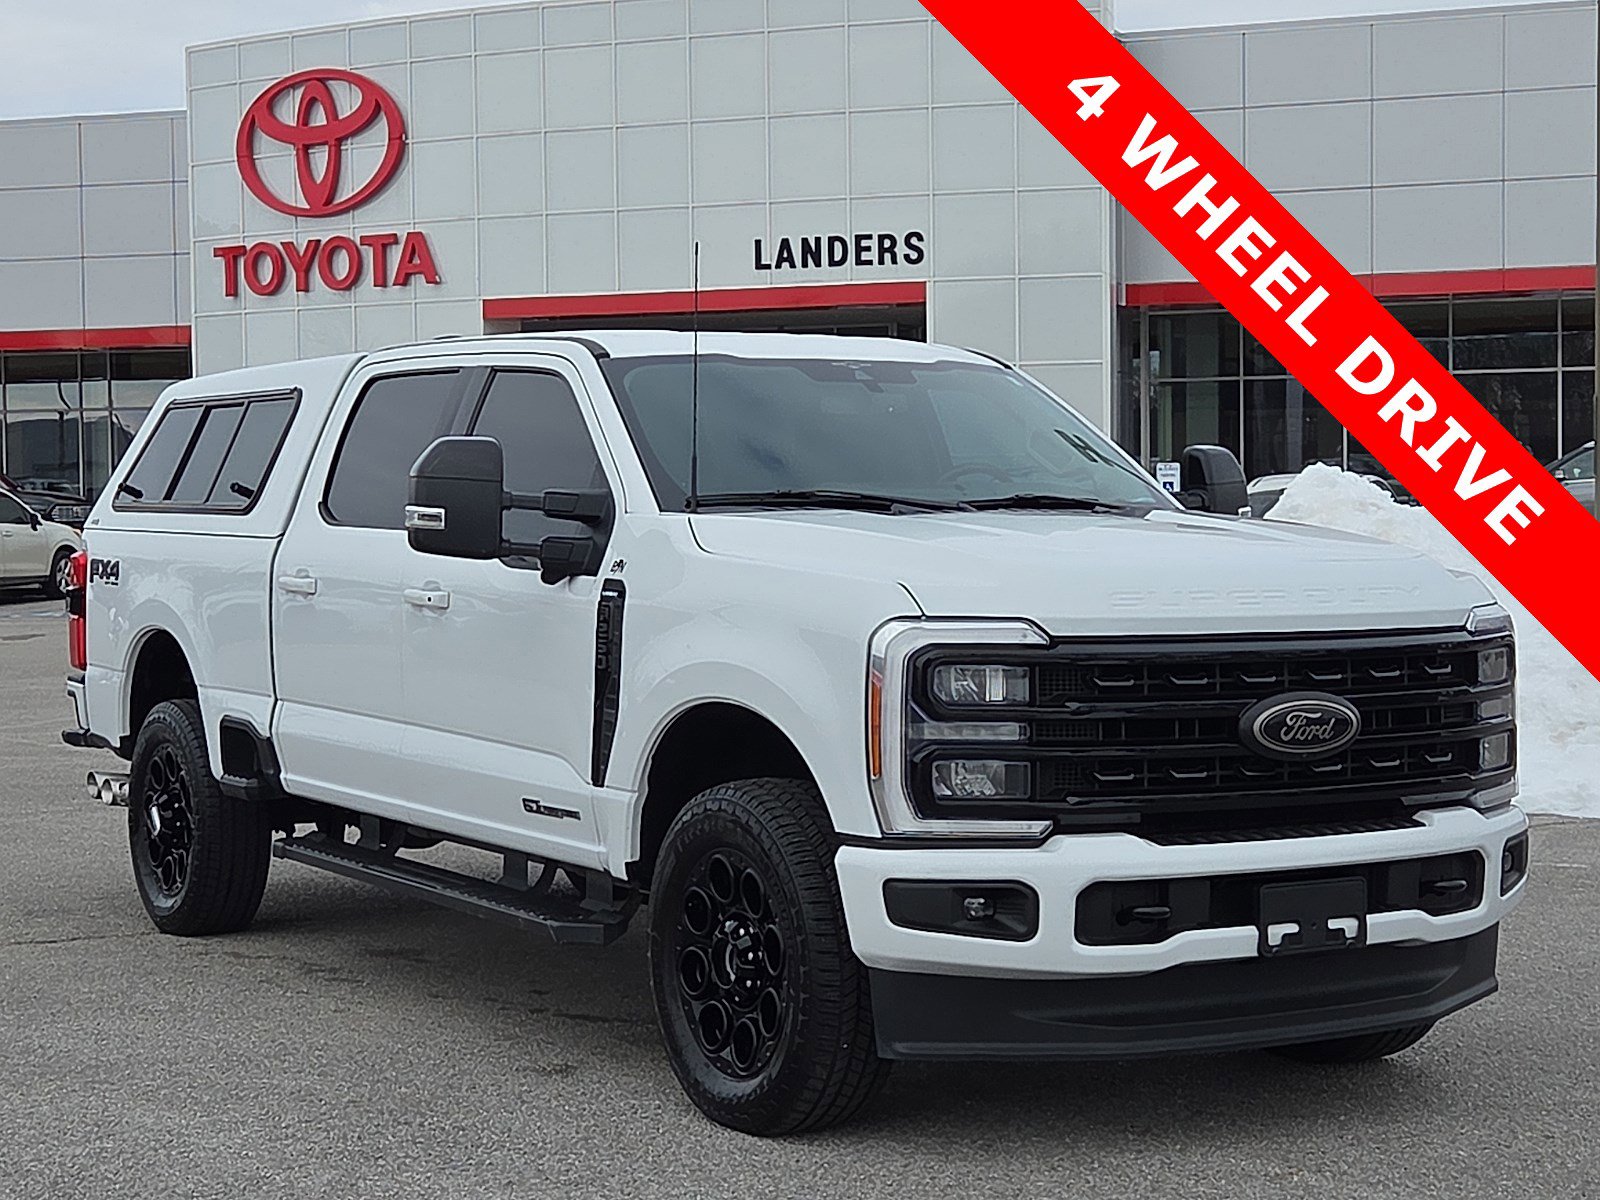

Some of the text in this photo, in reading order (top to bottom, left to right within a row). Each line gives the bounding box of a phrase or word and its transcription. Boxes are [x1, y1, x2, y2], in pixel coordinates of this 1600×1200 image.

[213, 231, 441, 297] TOYOTA
[754, 231, 925, 271] LANDERS
[89, 558, 120, 583] FX4
[1280, 711, 1336, 742] Ford
